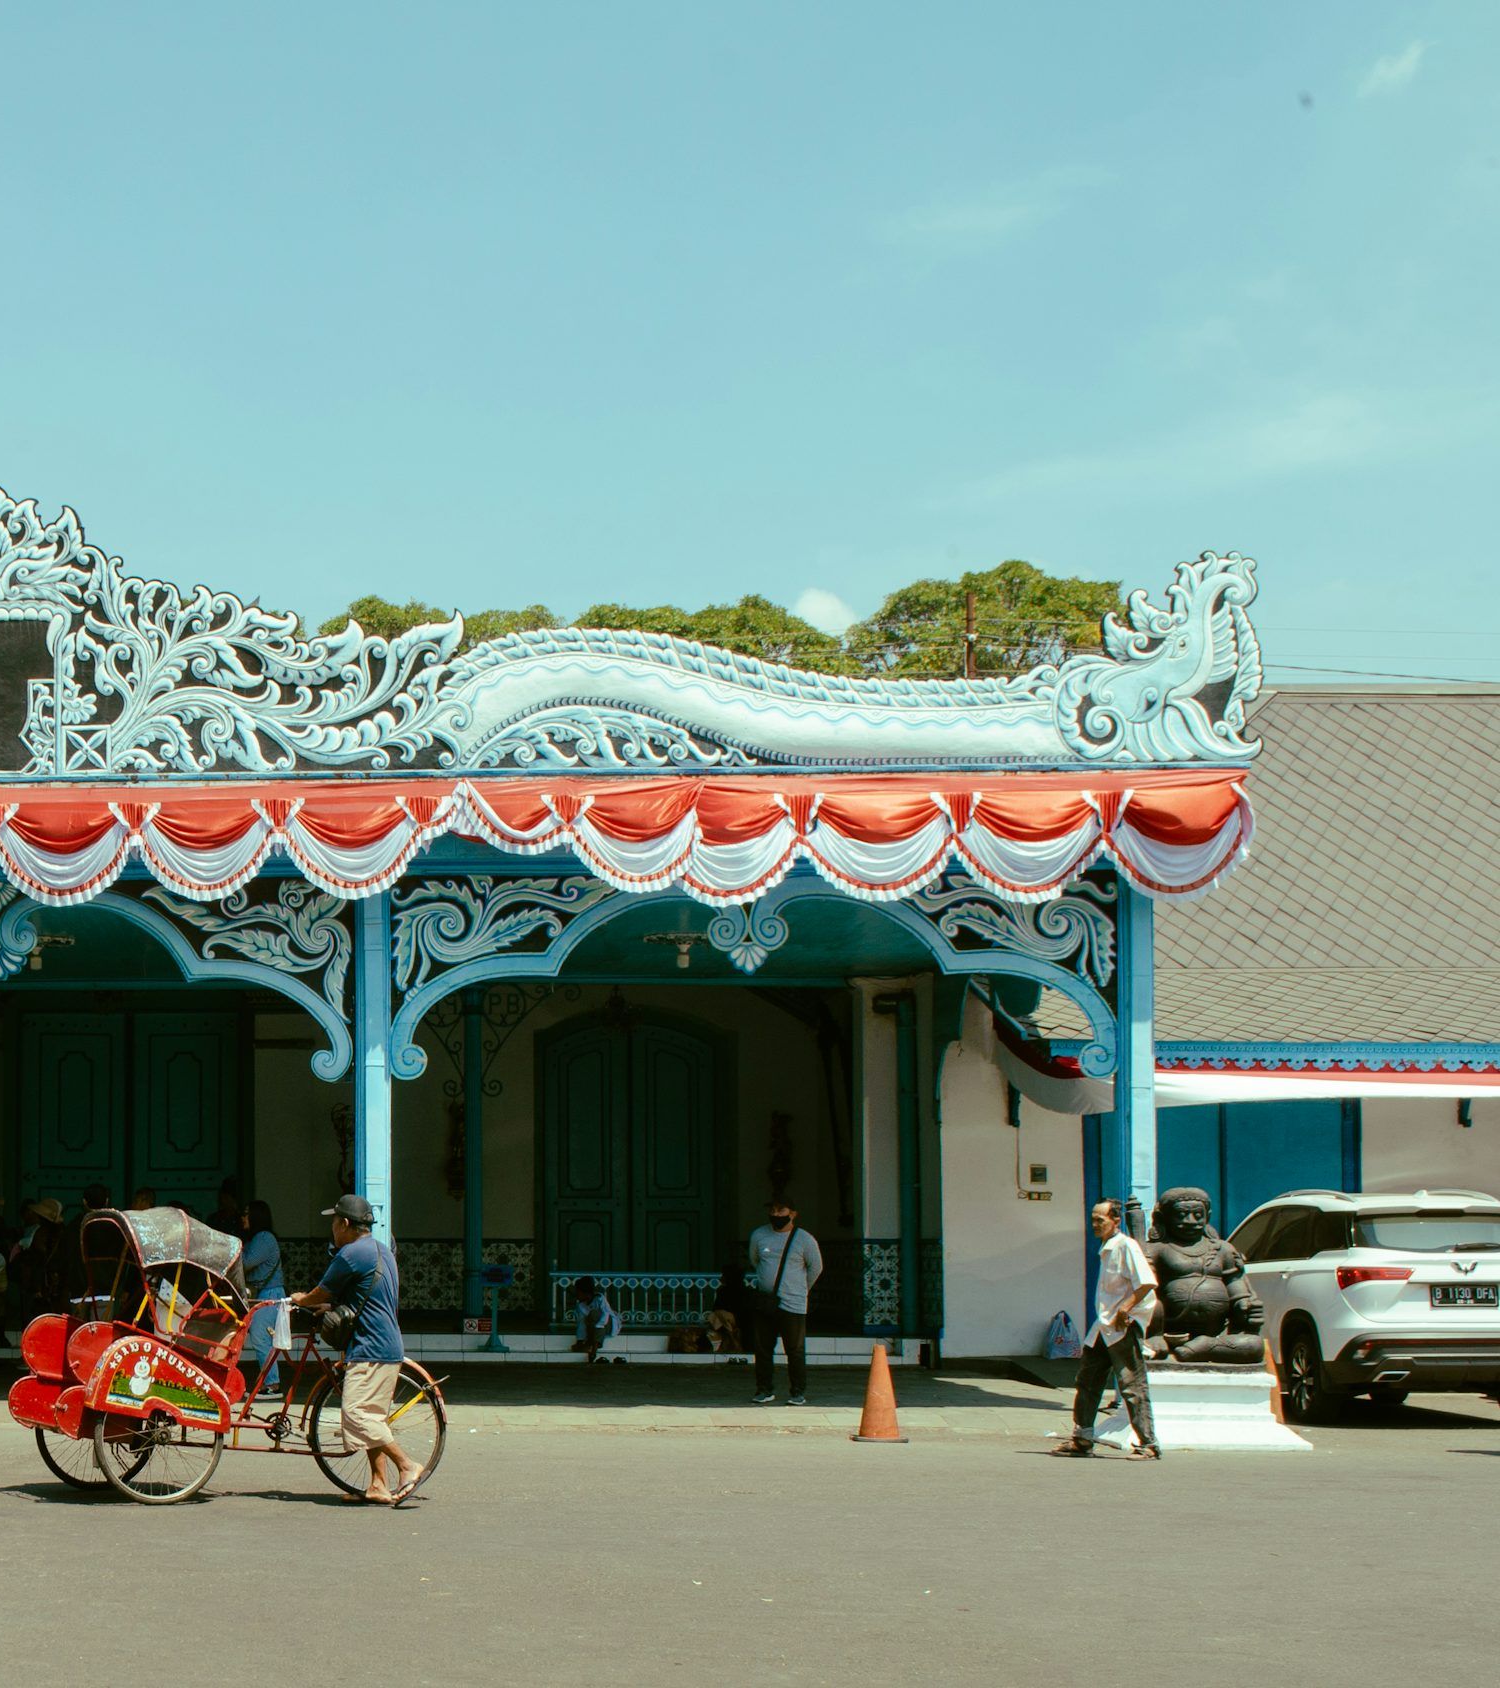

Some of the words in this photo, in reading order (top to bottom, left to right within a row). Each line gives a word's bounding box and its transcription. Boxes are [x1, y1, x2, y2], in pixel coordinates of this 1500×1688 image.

[1435, 1287, 1443, 1299] B
[1449, 1287, 1472, 1299] 1130
[113, 1341, 152, 1363] SIDO
[156, 1347, 204, 1386] MULYO
